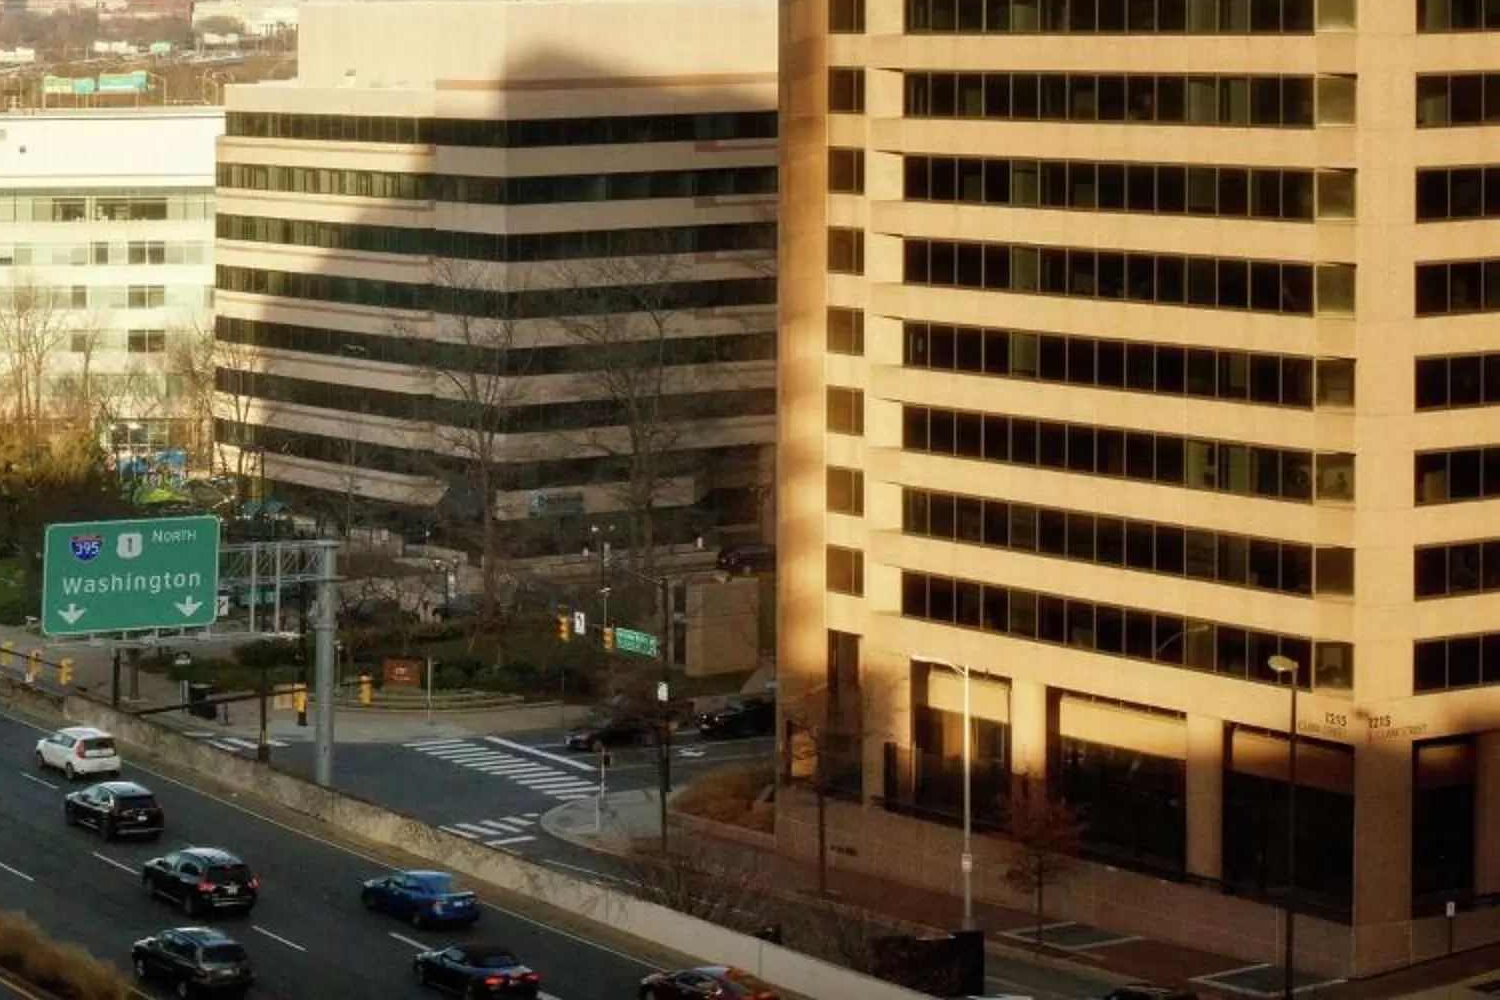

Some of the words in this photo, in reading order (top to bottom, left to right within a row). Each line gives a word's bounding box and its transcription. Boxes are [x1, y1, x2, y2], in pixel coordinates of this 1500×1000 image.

[75, 542, 99, 555] 395
[152, 530, 197, 543] NORTH
[62, 571, 201, 596] Washington
[1325, 711, 1347, 726] 1215
[1368, 714, 1391, 729] 1215
